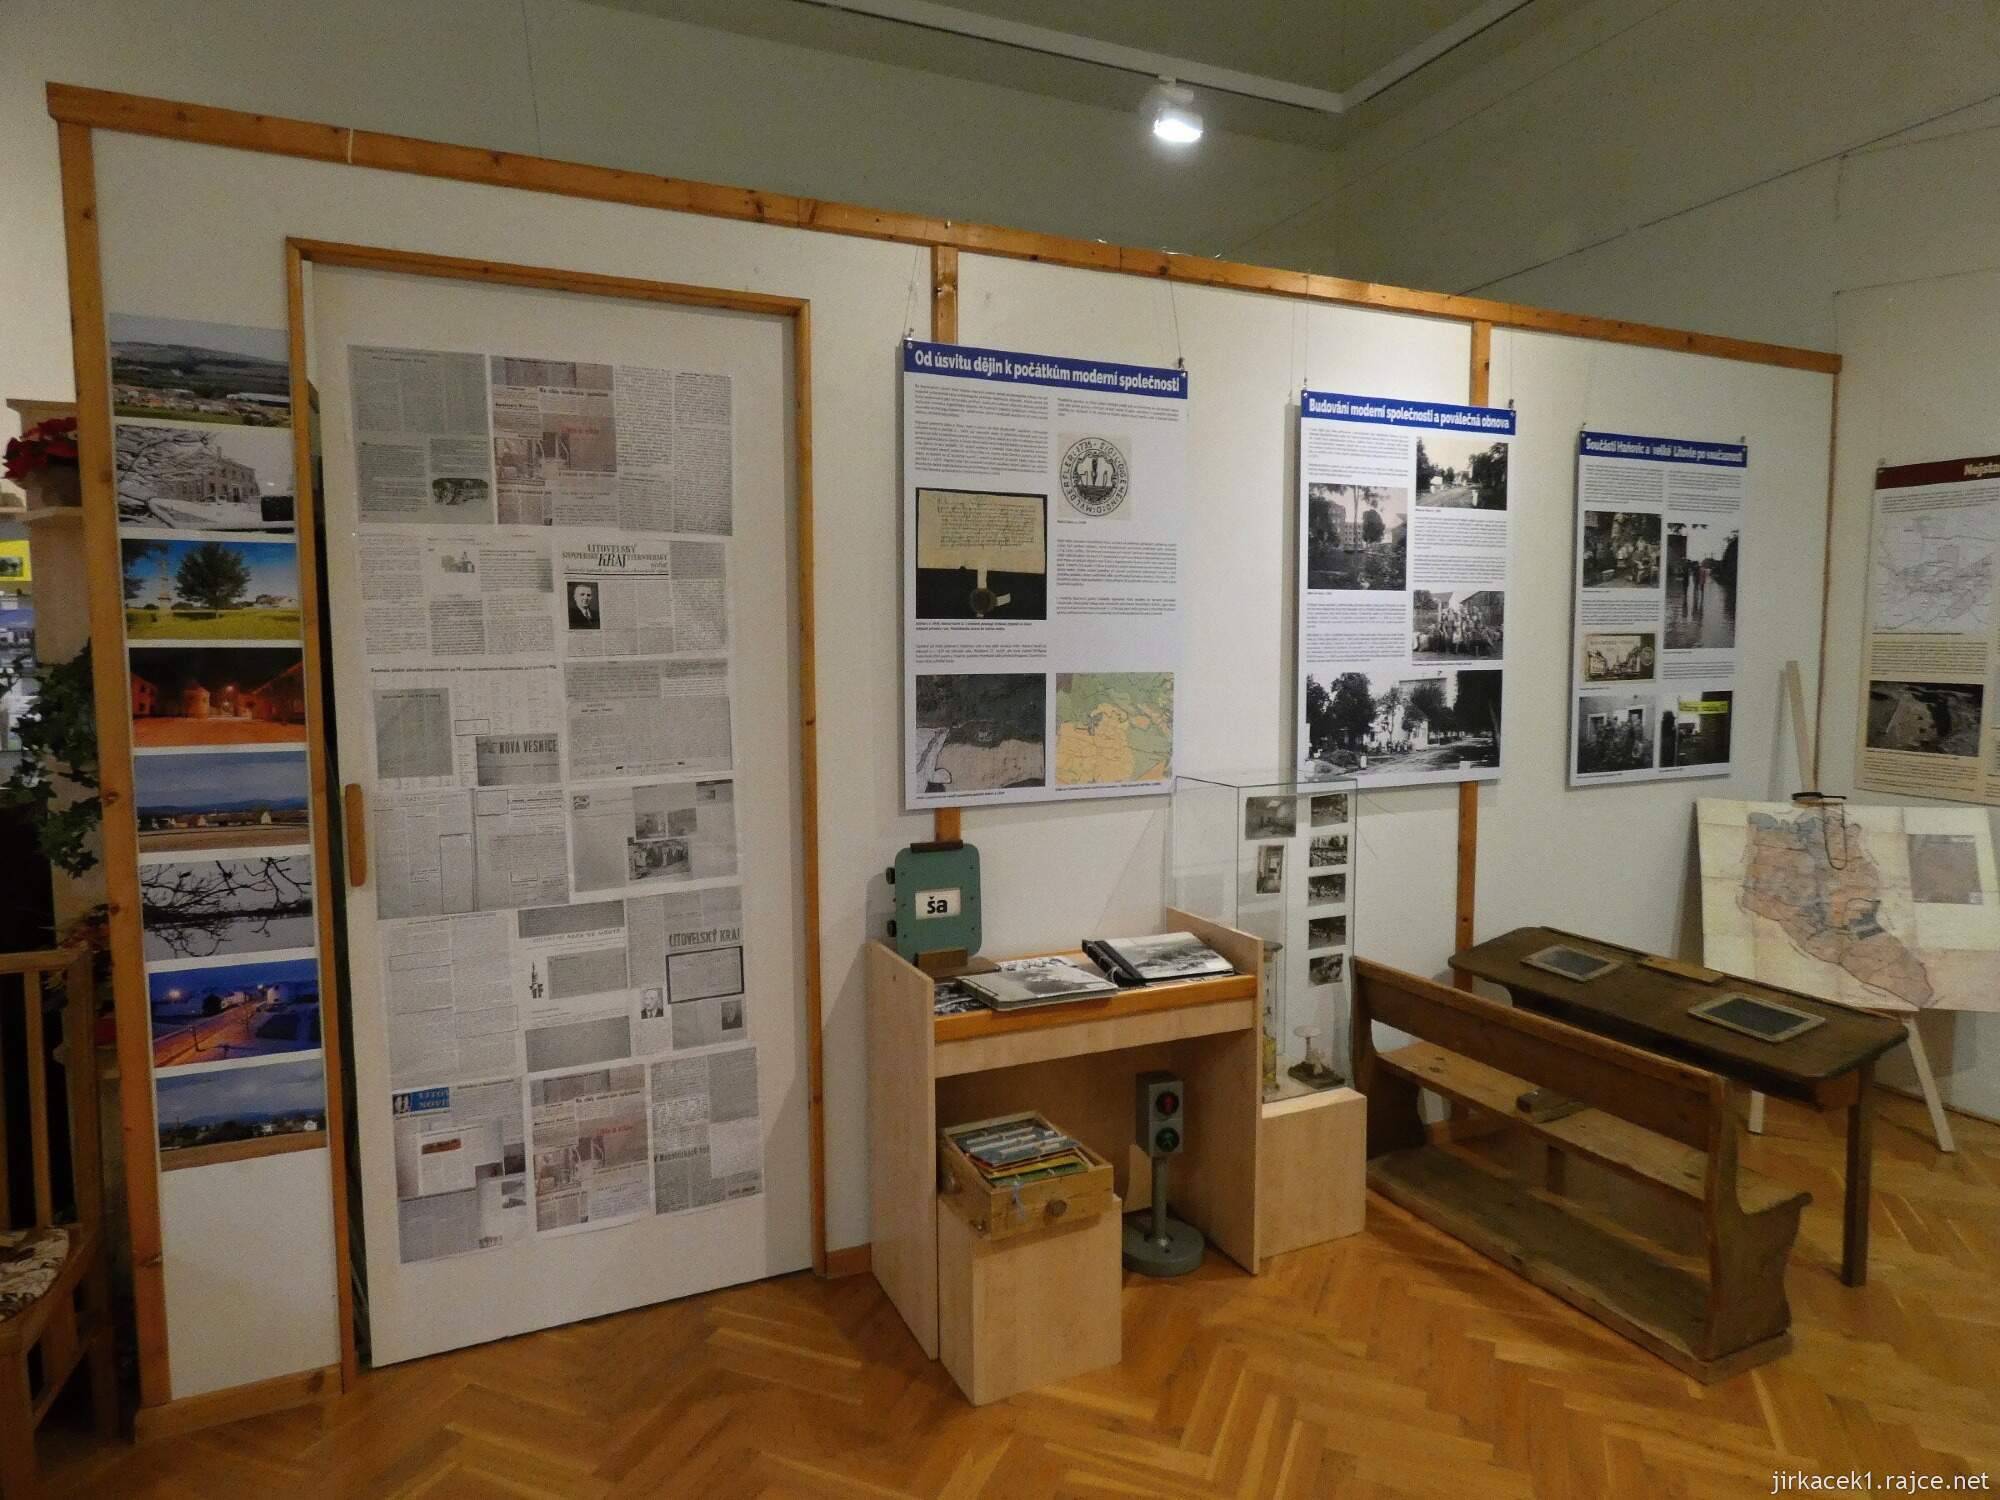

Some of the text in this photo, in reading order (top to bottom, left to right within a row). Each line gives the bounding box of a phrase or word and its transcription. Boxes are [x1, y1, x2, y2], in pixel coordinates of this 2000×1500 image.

[914, 350, 1180, 391] Od úsvitu dějin k počátkům moderní společnosti
[1309, 398, 1510, 429] Budování moderní společnosti a poválečná obnova
[926, 896, 948, 915] ša
